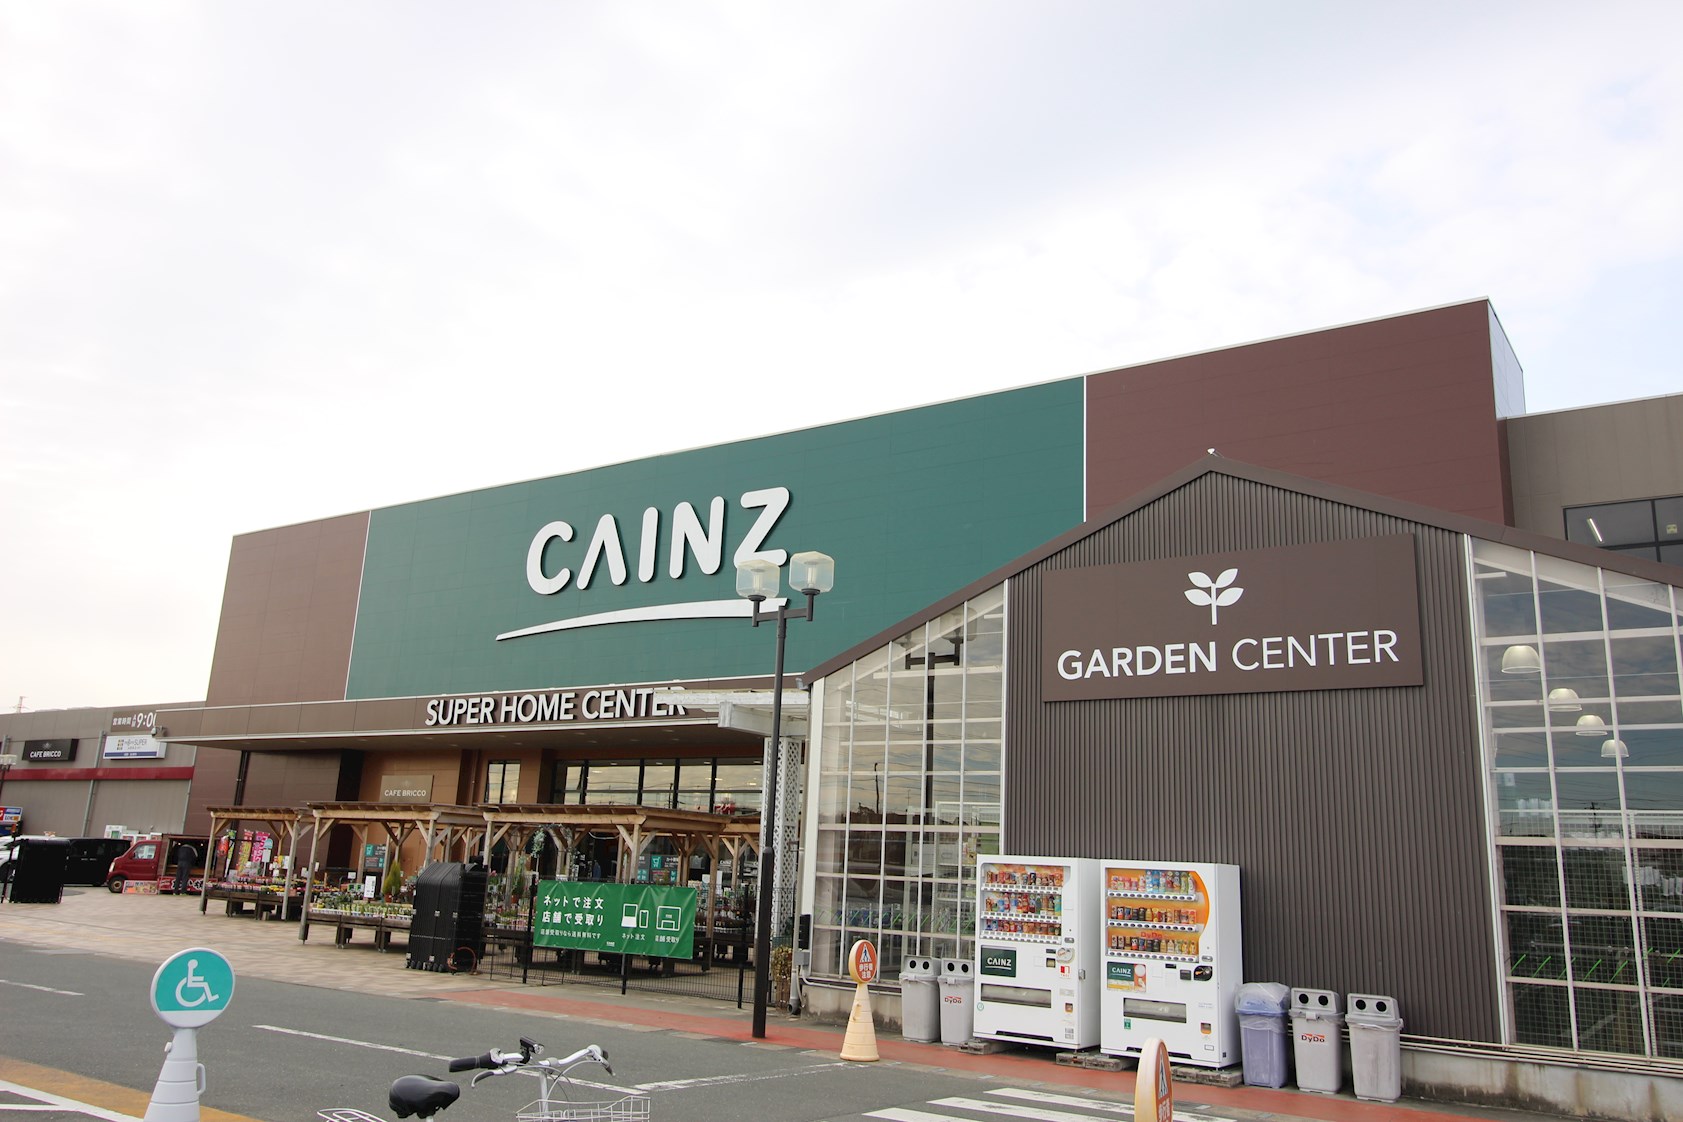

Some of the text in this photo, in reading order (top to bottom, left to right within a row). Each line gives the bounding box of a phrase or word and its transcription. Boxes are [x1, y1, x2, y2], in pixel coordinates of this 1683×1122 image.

[526, 486, 790, 595] CAINZ
[1057, 629, 1400, 680] GARDEN CENTER
[425, 697, 495, 726] SUPER
[500, 692, 576, 723] HOME
[43, 750, 62, 758] BRICCO
[384, 789, 427, 797] CAFE BRICCO
[543, 894, 604, 910] ネットで注文
[541, 910, 604, 927] 店舗で受取り
[986, 957, 1012, 967] CAINZ
[1111, 966, 1132, 975] CAINZ
[944, 996, 962, 1004] DyDo
[1300, 1033, 1325, 1043] DyDo
